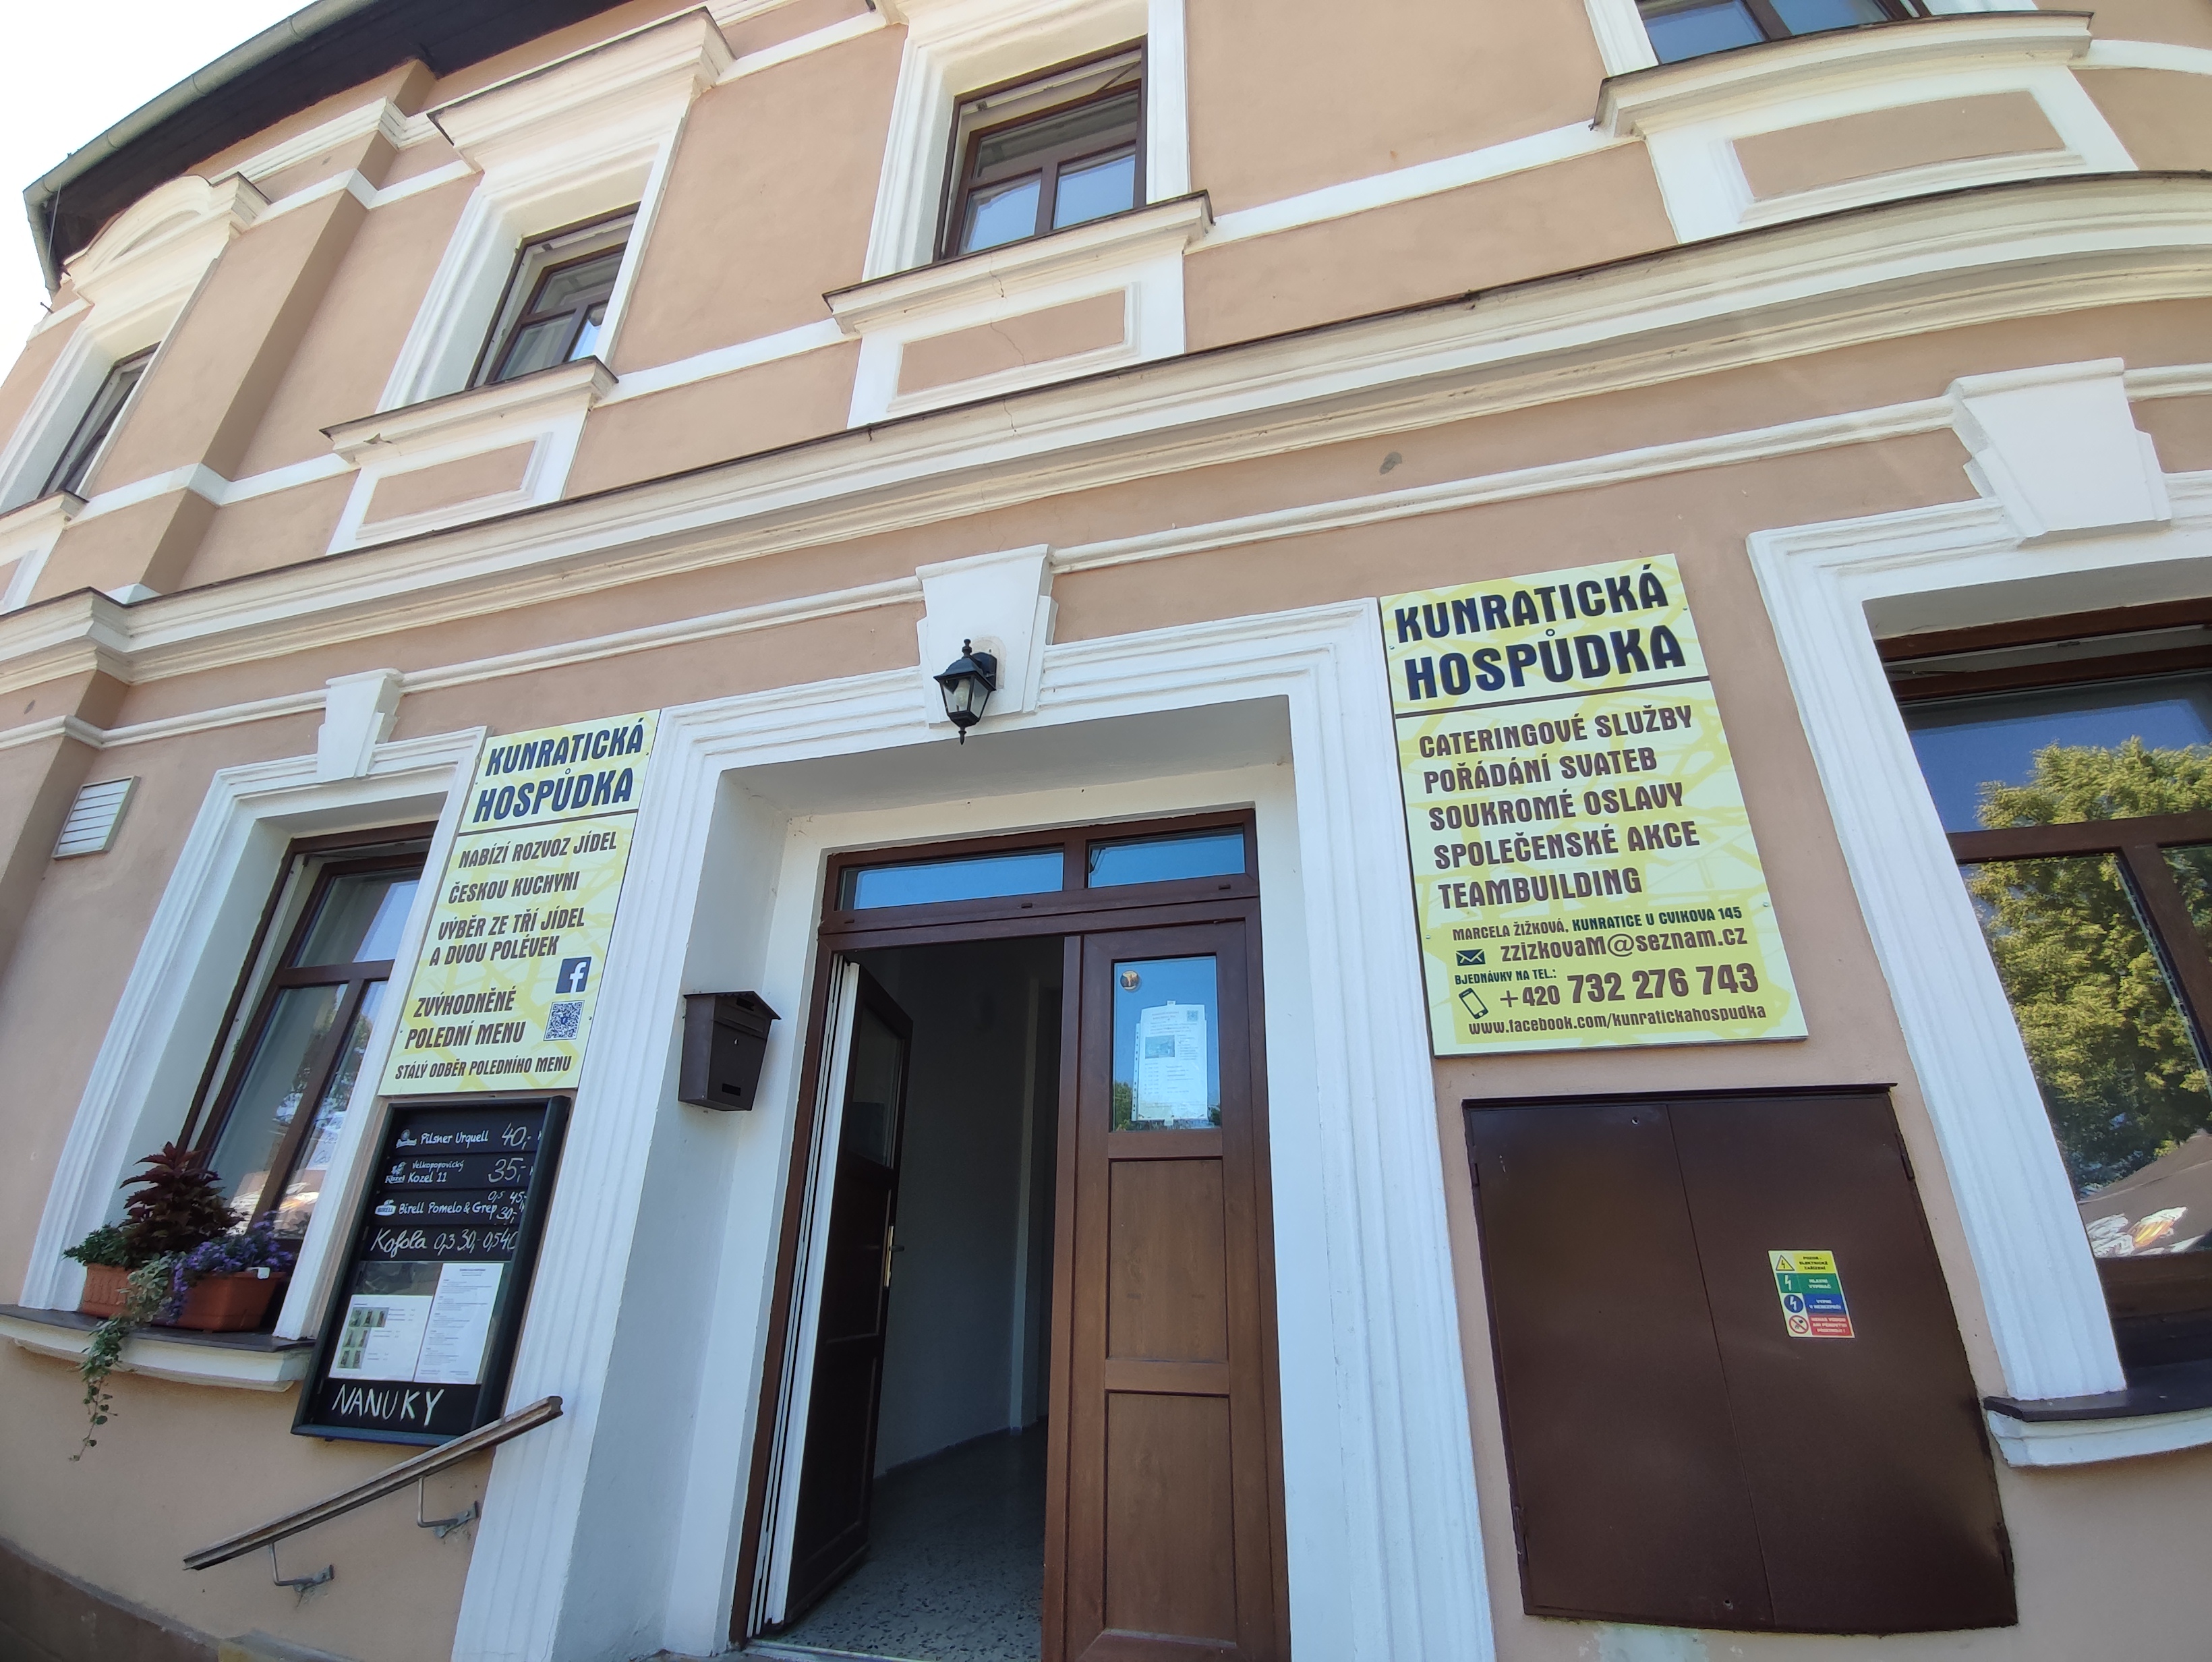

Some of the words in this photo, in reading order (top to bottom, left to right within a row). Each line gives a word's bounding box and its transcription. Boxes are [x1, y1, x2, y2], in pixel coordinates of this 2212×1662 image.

[1395, 563, 1669, 643] KUNRATICKÁ
[1404, 625, 1687, 701] HOSPŮDKA
[485, 717, 644, 777] KUNRATICKÁ
[1419, 712, 1588, 758] CATERINGOVÉ
[1594, 704, 1691, 738] SLUŽBY
[1423, 753, 1552, 795] POŘÁDÁNÍ
[1559, 747, 1657, 780] SVATEB
[472, 767, 632, 823] HOSPŮDKA
[1428, 788, 1577, 831] SOUKROMÉ
[1583, 782, 1683, 815] OSLAVY
[458, 840, 511, 869] NABÍZÍ
[511, 837, 572, 862] ROZVOZ
[573, 830, 617, 855] JÍDEL
[1434, 823, 1619, 869] SPOLEČENSKÉ
[1627, 820, 1700, 852] AKCE
[448, 880, 509, 905] ČESKOU
[511, 871, 581, 897] KUCHYNI
[1437, 867, 1643, 909] TEAMBUILDING
[438, 914, 486, 941] VÝBĚR
[488, 915, 510, 935] ZE
[512, 907, 540, 934] TŘÍ
[540, 905, 585, 931] JÍDEL
[1452, 925, 1511, 941] MARCELA
[1571, 914, 1643, 932] KUNRATICE
[1645, 913, 1655, 926] U
[1658, 909, 1716, 925] CVIKOVA
[1718, 906, 1743, 920] 145
[428, 946, 441, 967] A
[444, 942, 488, 965] DVOU
[489, 934, 560, 961] POLÉVEK
[1499, 985, 1561, 1008] +420
[1567, 972, 1626, 1004] 732
[1631, 967, 1689, 1000] 276
[1695, 963, 1759, 996] 743
[1515, 970, 1530, 981] NA
[413, 985, 517, 1018] ZVÝHODNĚNÉ
[404, 1020, 475, 1050] POLEDNÍ
[474, 1021, 527, 1045] MENU
[1468, 1004, 1767, 1035] www.facebook.com/kunratickahospudka
[395, 1060, 429, 1080] STÁLÝ
[429, 1058, 467, 1078] ODBĚR
[468, 1055, 533, 1076] POLEDNÍHO
[534, 1056, 573, 1072] MENU
[420, 1133, 453, 1145] Pilsner
[455, 1130, 489, 1149] Urquell
[407, 1171, 434, 1184] Kozel
[436, 1172, 447, 1182] 11
[412, 1159, 465, 1172] Velkopopovický
[399, 1202, 424, 1215] Birell
[428, 1204, 461, 1214] Pomelo
[463, 1202, 471, 1214] &
[472, 1203, 498, 1220] Grep
[370, 1227, 428, 1259] Kofola
[331, 1383, 445, 1427] NANUKY
